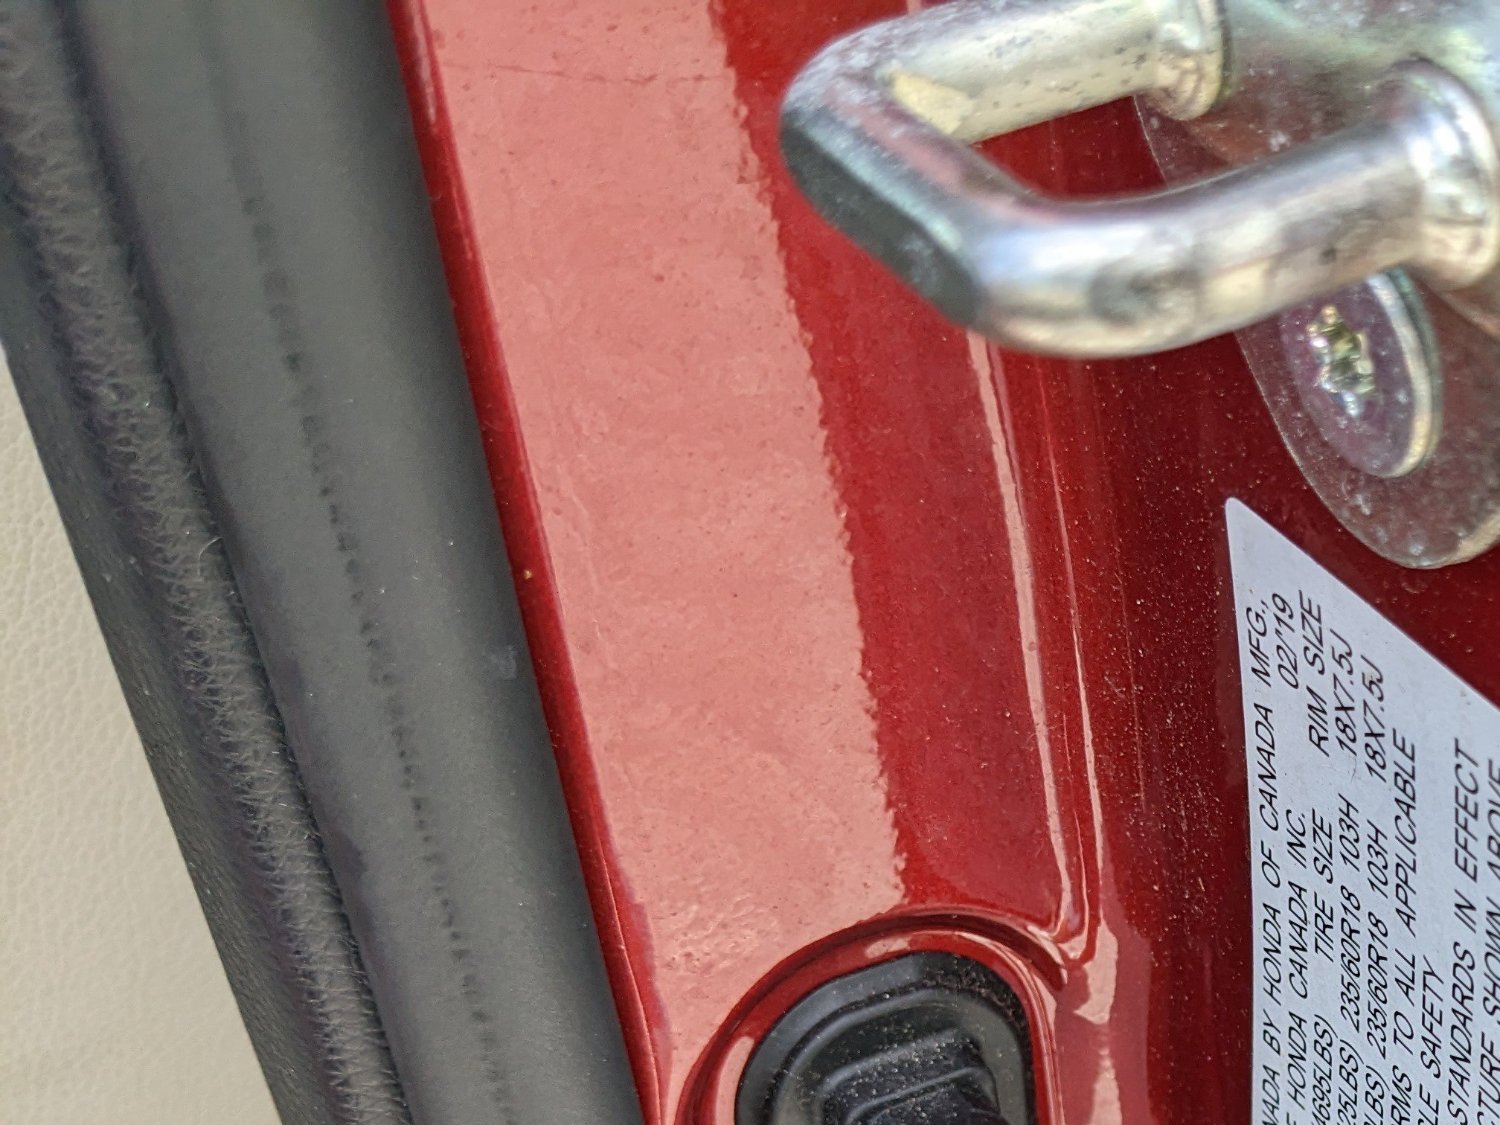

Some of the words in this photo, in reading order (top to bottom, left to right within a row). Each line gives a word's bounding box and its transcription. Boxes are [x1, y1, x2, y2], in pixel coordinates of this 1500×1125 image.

[1245, 599, 1271, 688] MFG.,
[1270, 592, 1299, 690] 02/'19
[1297, 588, 1325, 676] SIZE
[1305, 684, 1330, 758] RIM
[1328, 627, 1357, 757] 18X7.5J
[1359, 653, 1387, 783] 18X7.5J
[1252, 701, 1279, 832] CANADA
[1453, 736, 1479, 883] EFFECT
[1259, 839, 1281, 889] OF
[1284, 808, 1307, 869] INC.
[1310, 806, 1334, 884] SIZE
[1337, 791, 1360, 872] 103H
[1365, 818, 1389, 899] 103H
[1391, 726, 1417, 938] APPLICABLE
[1261, 901, 1282, 1006] HONDA
[1286, 879, 1308, 999] CANADA
[1313, 890, 1334, 963] TIRE
[1453, 888, 1477, 934] IN
[1339, 883, 1361, 1034] 235/60R18
[1365, 910, 1388, 1060] 235/60R18
[1393, 947, 1416, 1007] ALL
[1262, 1008, 1281, 1056] BY
[1286, 1010, 1307, 1111] HONDA
[1392, 1009, 1414, 1055] TO
[1419, 953, 1444, 1079] SAFETY
